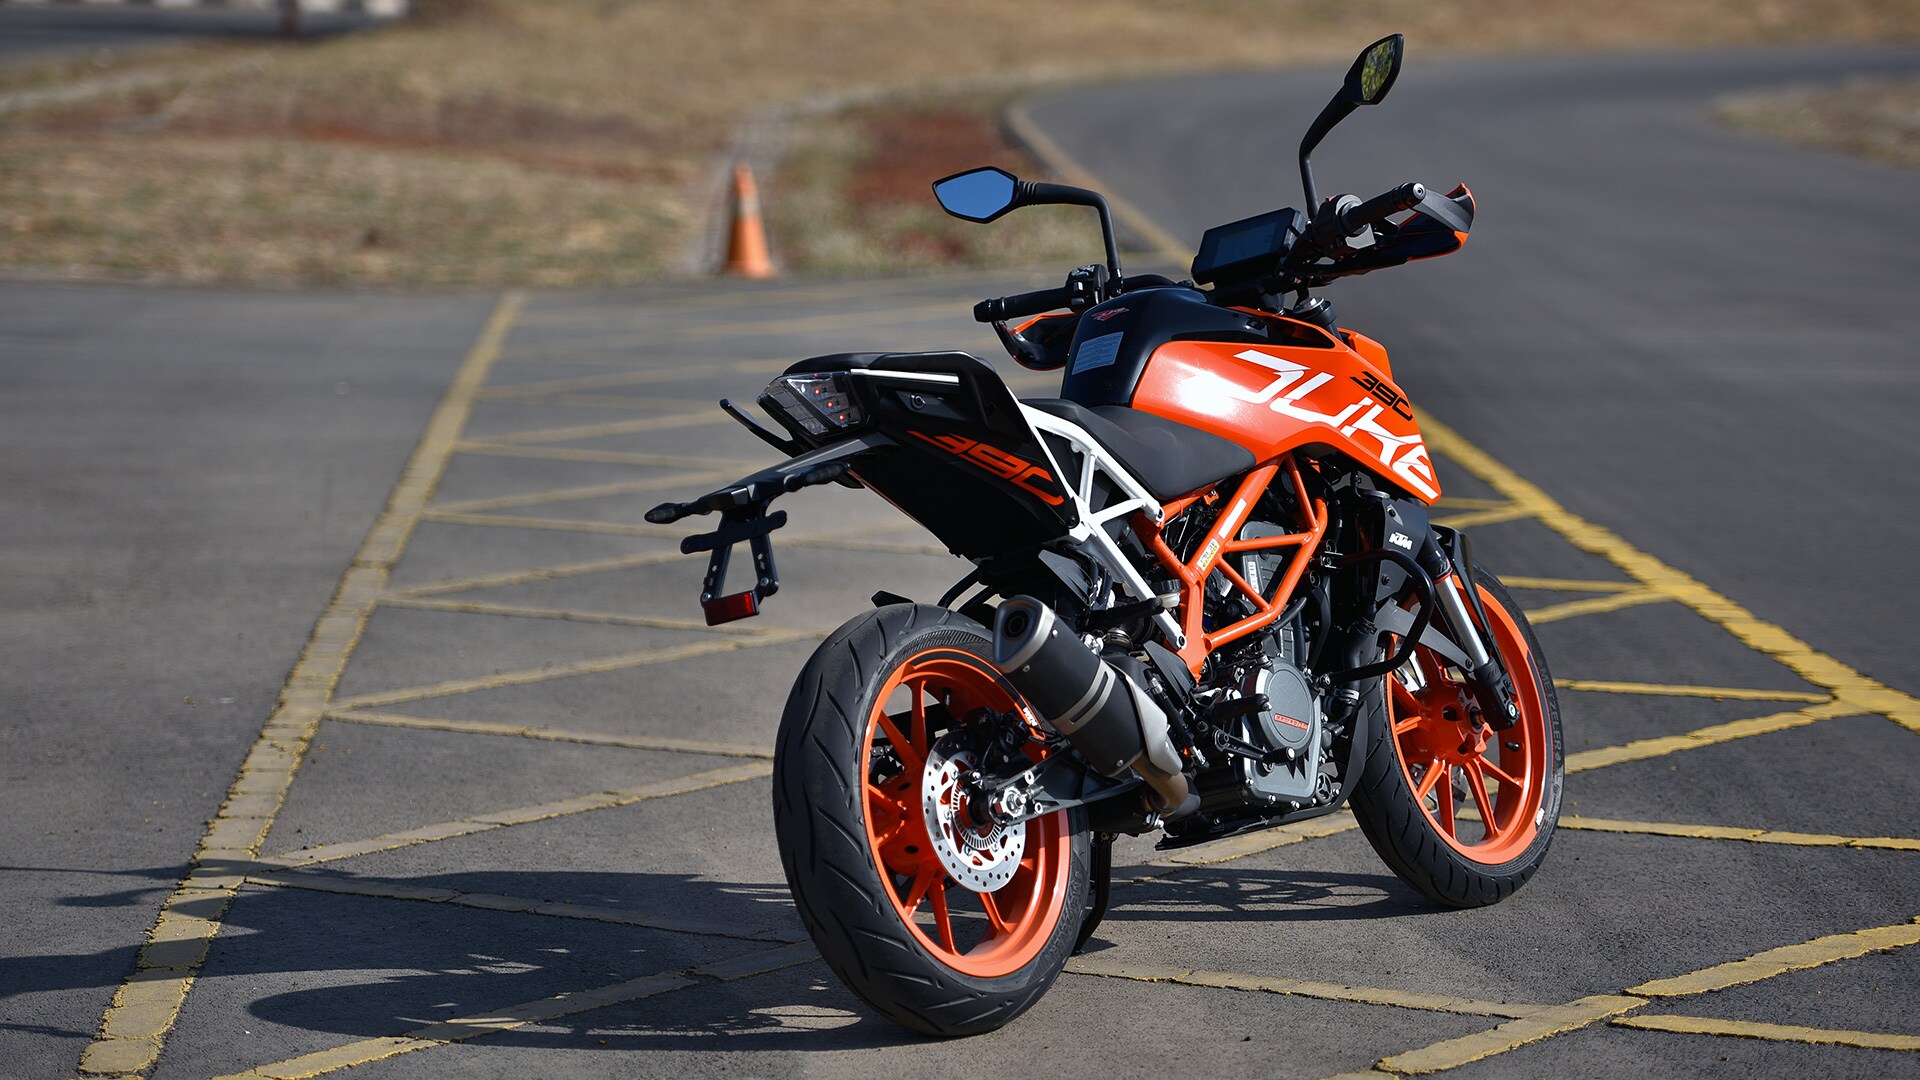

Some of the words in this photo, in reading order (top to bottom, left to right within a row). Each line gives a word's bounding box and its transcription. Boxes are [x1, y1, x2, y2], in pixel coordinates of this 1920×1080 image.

[1349, 371, 1413, 421] 390
[907, 430, 1064, 506] 390
[1389, 531, 1413, 550] KTM
